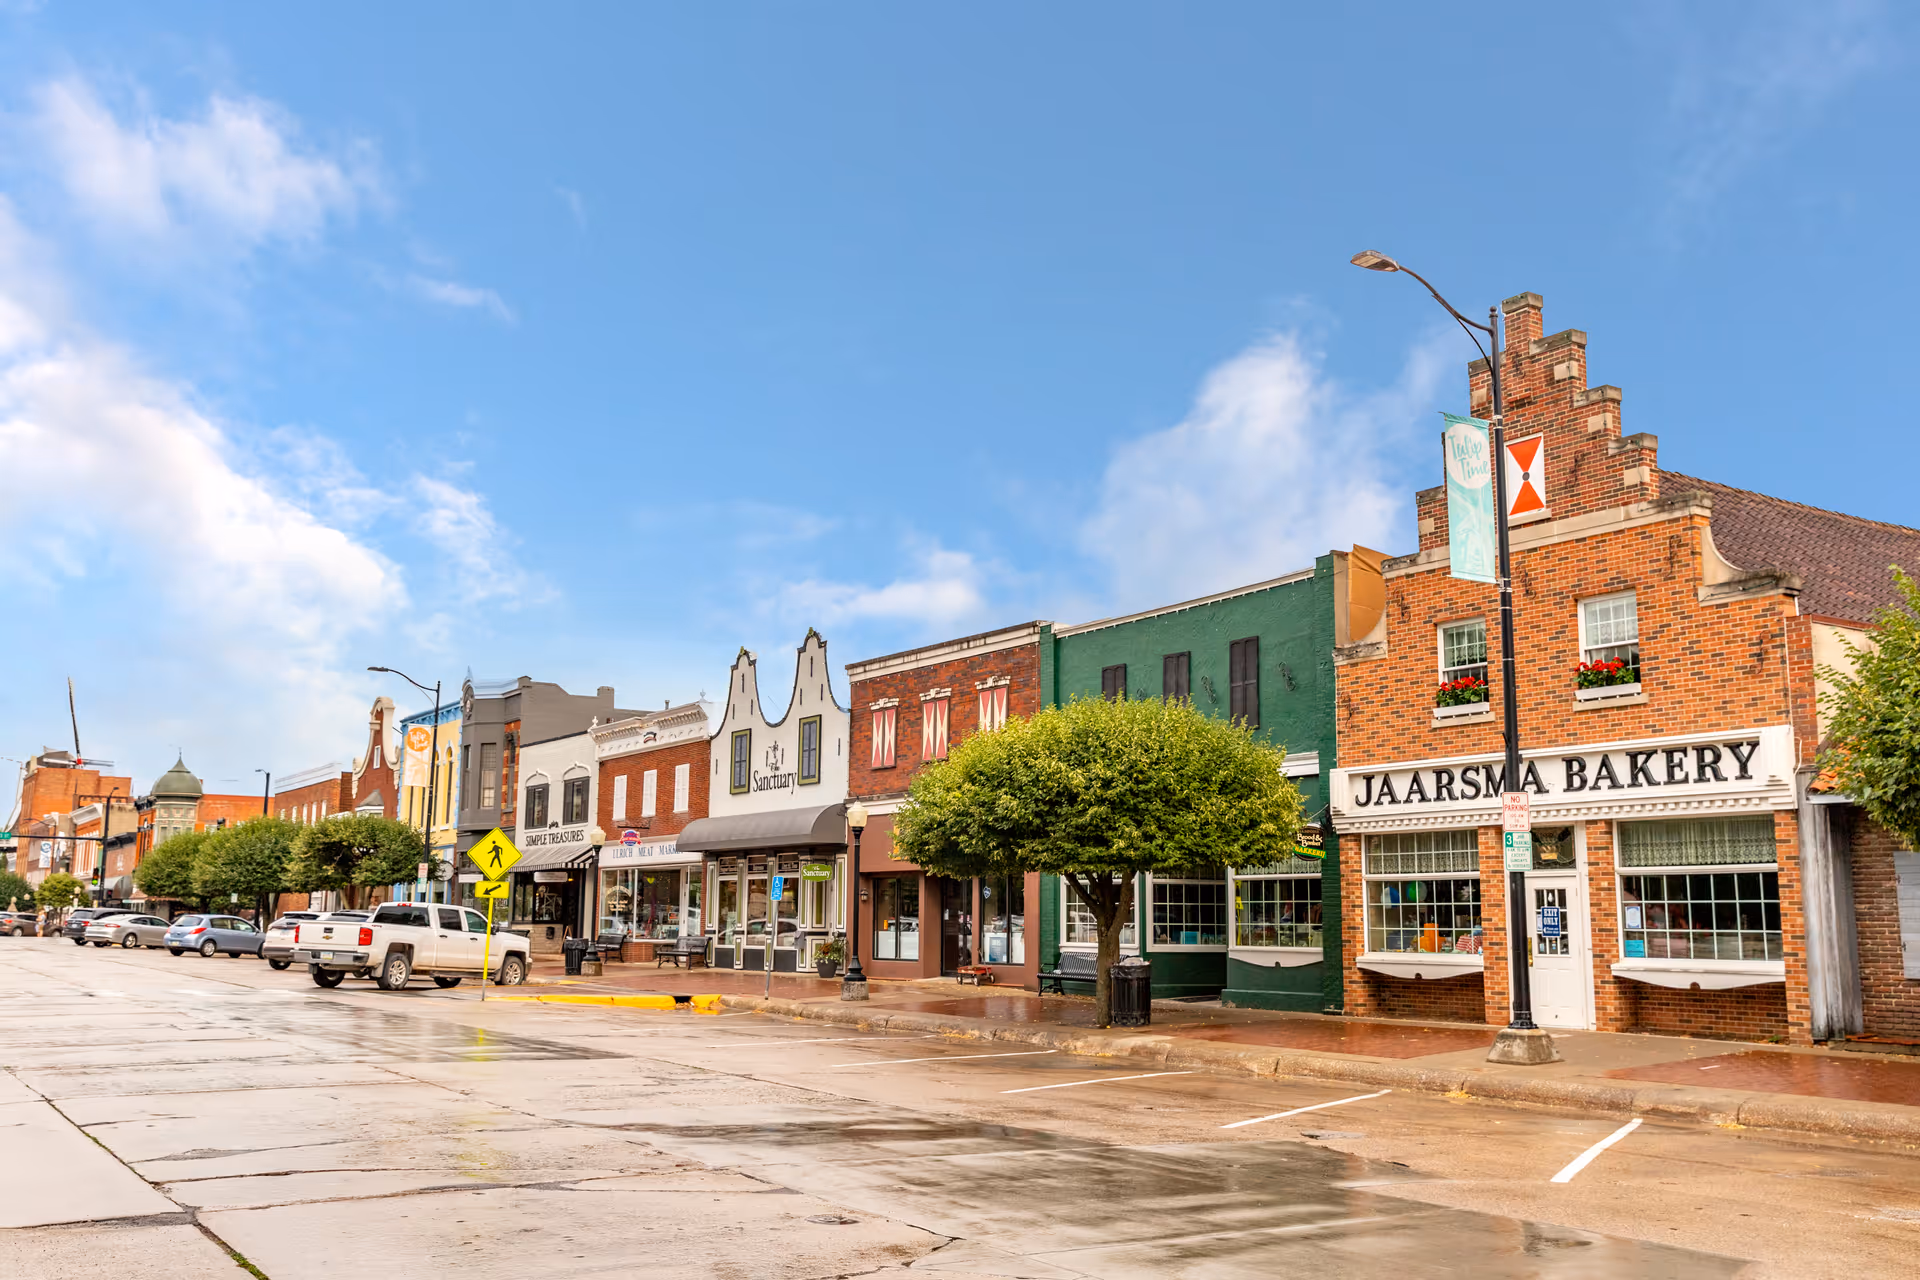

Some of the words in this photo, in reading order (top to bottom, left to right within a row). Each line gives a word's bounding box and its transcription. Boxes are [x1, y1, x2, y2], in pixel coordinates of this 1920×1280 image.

[1448, 435, 1481, 460] Tulip
[1458, 457, 1490, 480] Time
[769, 759, 780, 772] The
[1355, 760, 1549, 807] JAARSMA
[1561, 740, 1760, 793] BAKERY
[753, 770, 797, 795] Sanctuary
[526, 834, 548, 847] SIMPLE
[548, 829, 584, 844] TREASURES
[1506, 835, 1512, 845] 3
[612, 847, 633, 858] ULRICH
[638, 846, 653, 857] MEAT
[803, 869, 831, 878] Sanctuary
[1543, 908, 1558, 917] EXIT
[1543, 917, 1558, 926] ONLY
